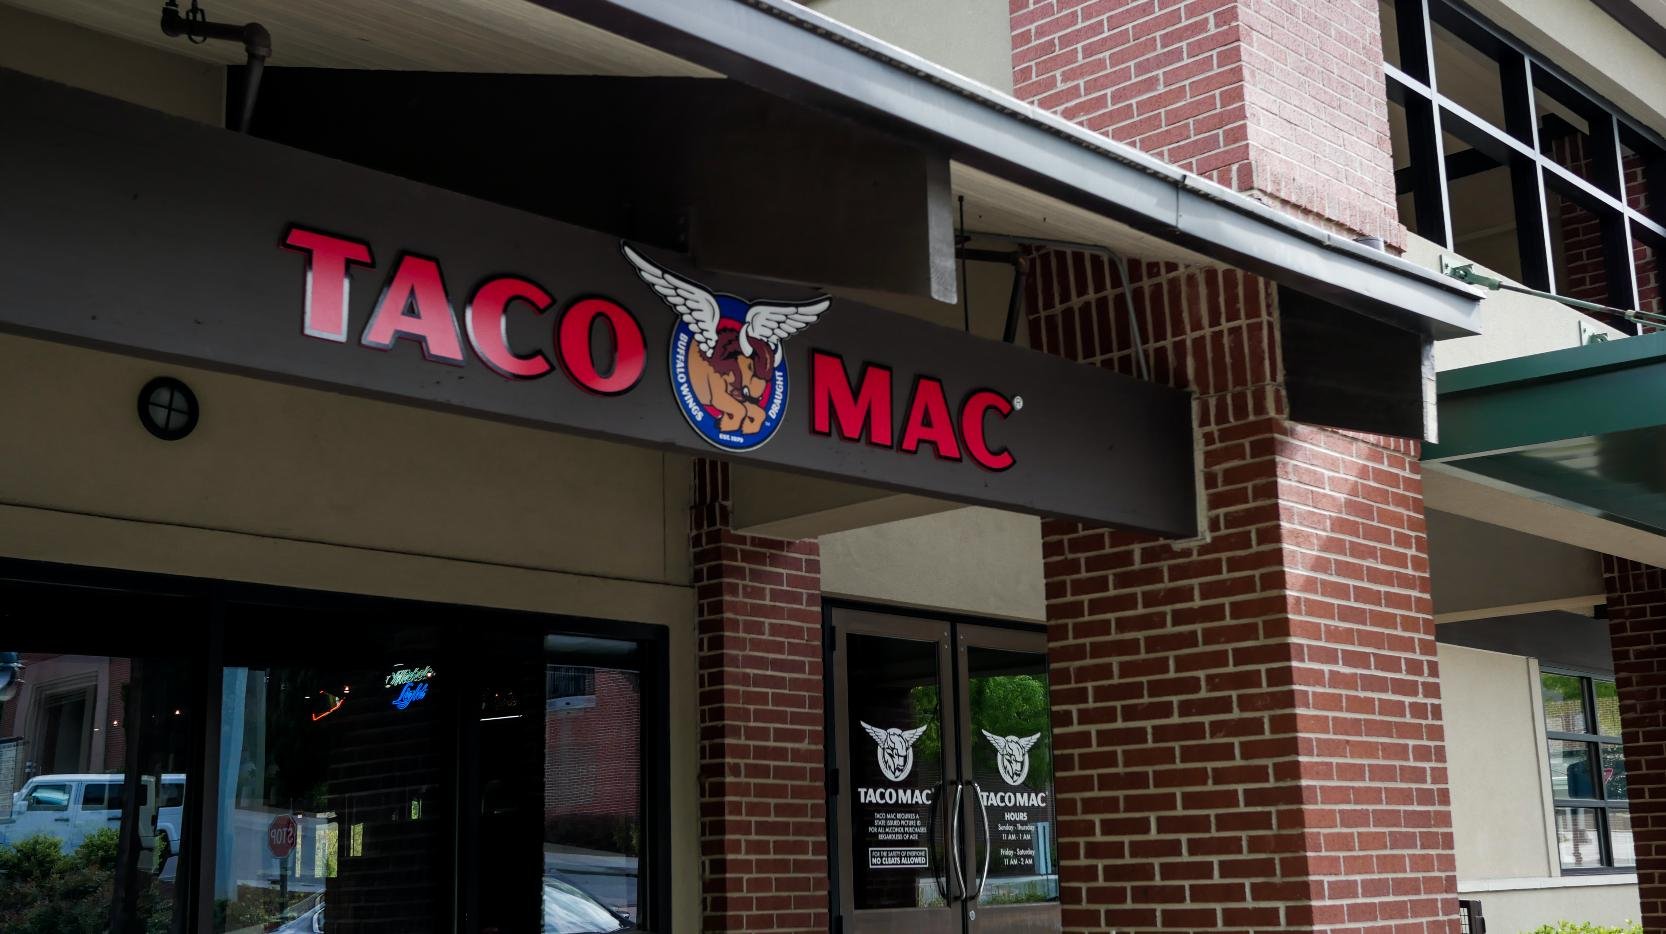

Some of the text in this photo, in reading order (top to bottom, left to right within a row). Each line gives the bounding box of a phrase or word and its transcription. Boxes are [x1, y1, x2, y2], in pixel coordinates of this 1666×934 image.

[281, 227, 1017, 472] TACO MAC
[676, 332, 689, 383] BUFFALO
[768, 371, 784, 419] DRAUGHT
[680, 383, 704, 421] WINGS
[874, 812, 886, 820] TACO
[1004, 812, 1028, 821] HOURS
[998, 823, 1014, 832] Sunday
[1017, 823, 1035, 832] Thursday
[1000, 848, 1014, 857] Friday
[1016, 848, 1035, 857] Saturday
[872, 856, 926, 865] NO CLEATS ALLOWED
[1004, 858, 1009, 866] 11
